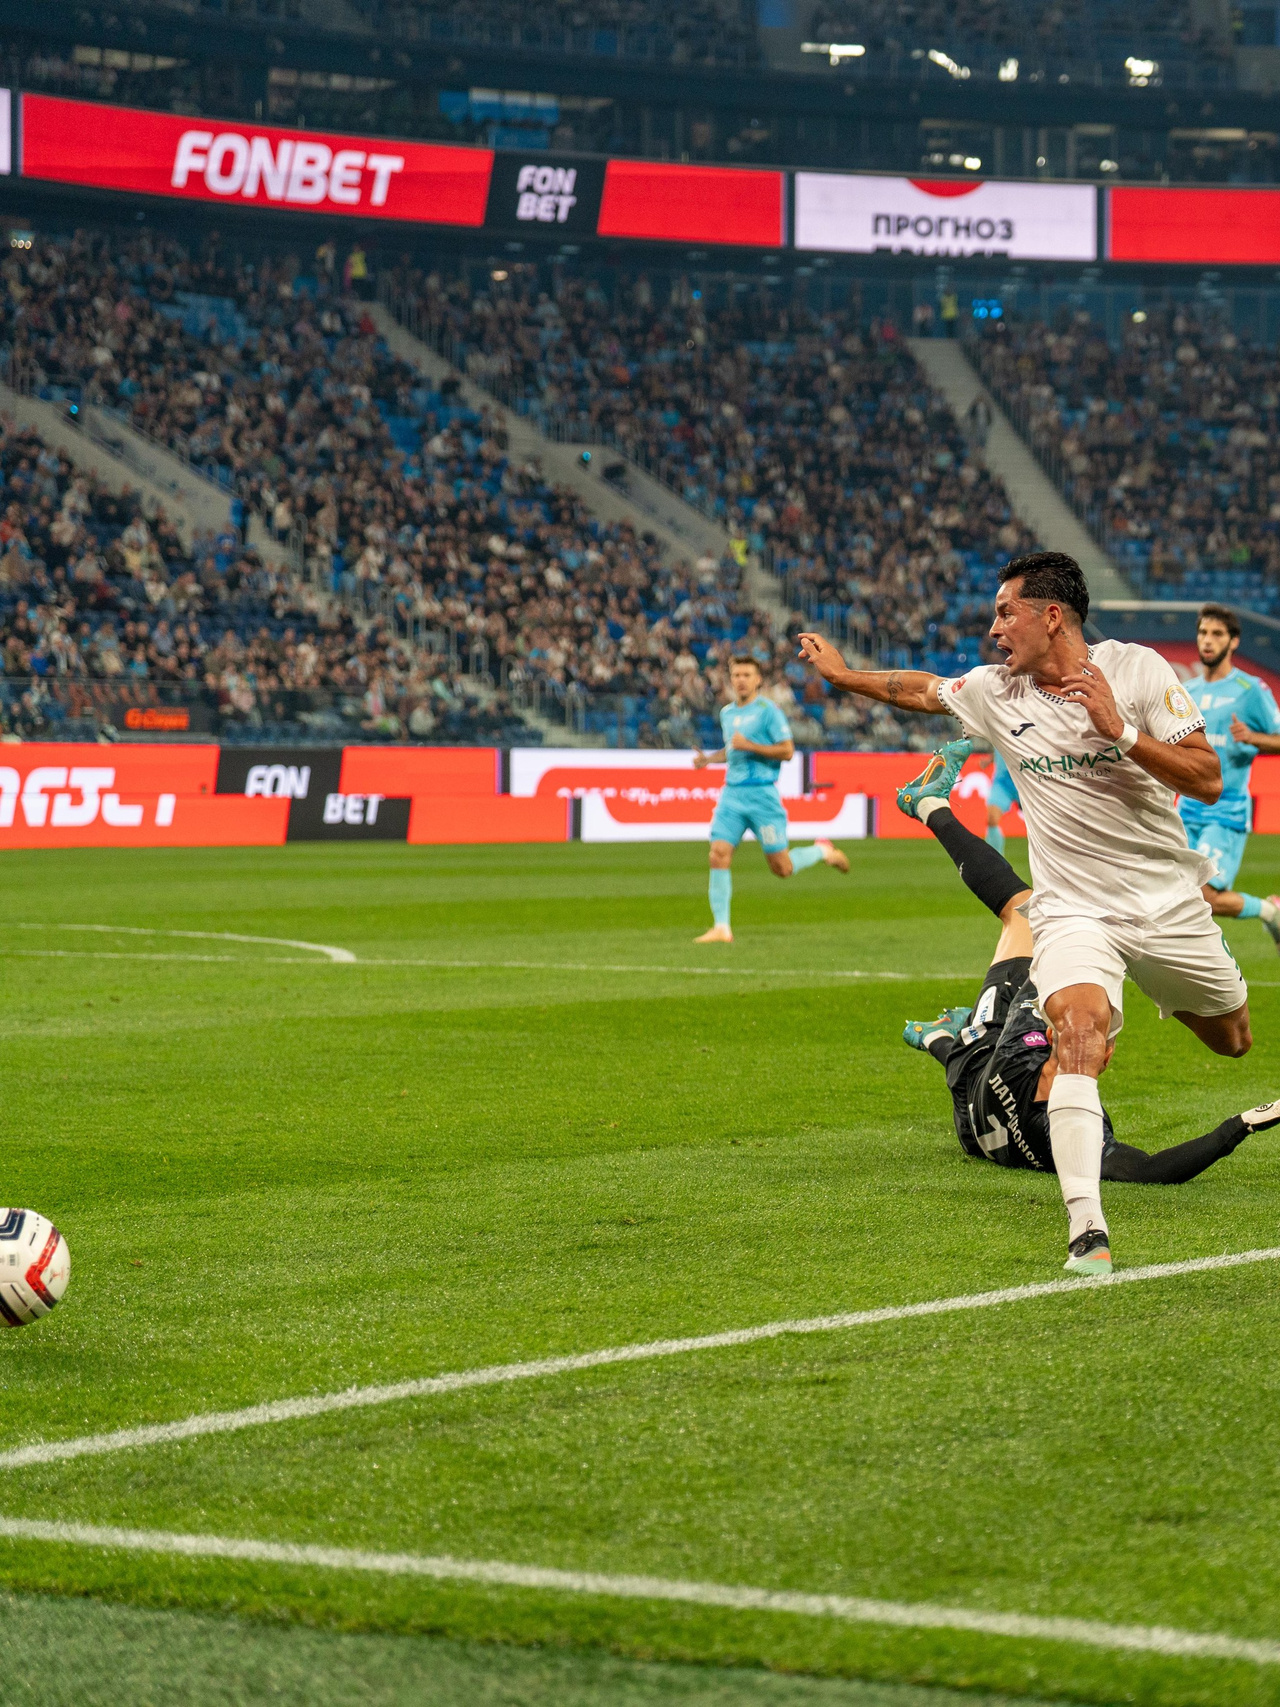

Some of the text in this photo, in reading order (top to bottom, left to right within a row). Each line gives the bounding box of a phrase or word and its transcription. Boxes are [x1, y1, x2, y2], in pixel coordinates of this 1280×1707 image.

[171, 130, 405, 205] FONBET
[518, 165, 577, 196] FON
[516, 193, 577, 223] BET
[872, 213, 1015, 240] ПРОГНОЗ
[246, 764, 311, 799] FON
[1037, 766, 1112, 783] FOUNDATION
[323, 793, 384, 825] BET
